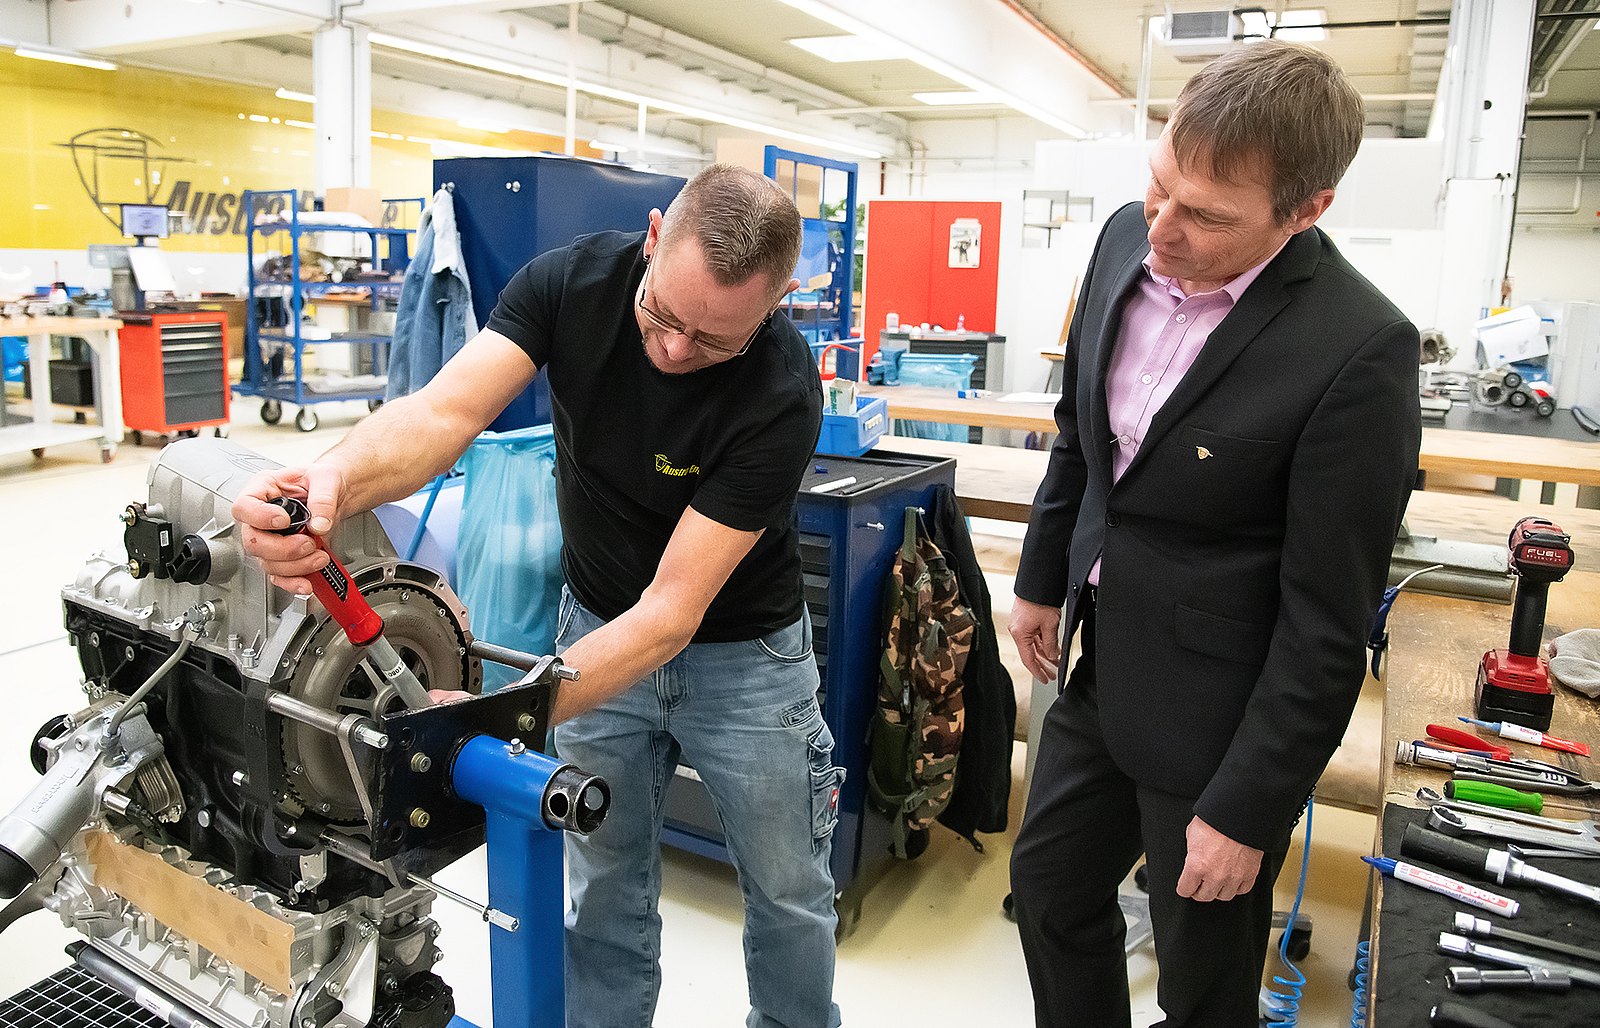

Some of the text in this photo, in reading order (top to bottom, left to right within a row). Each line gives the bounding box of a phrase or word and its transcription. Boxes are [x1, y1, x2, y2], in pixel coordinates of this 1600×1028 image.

[1527, 548, 1562, 558] FUEL
[1428, 884, 1484, 906] permanent marker
[1461, 885, 1498, 903] 3000
